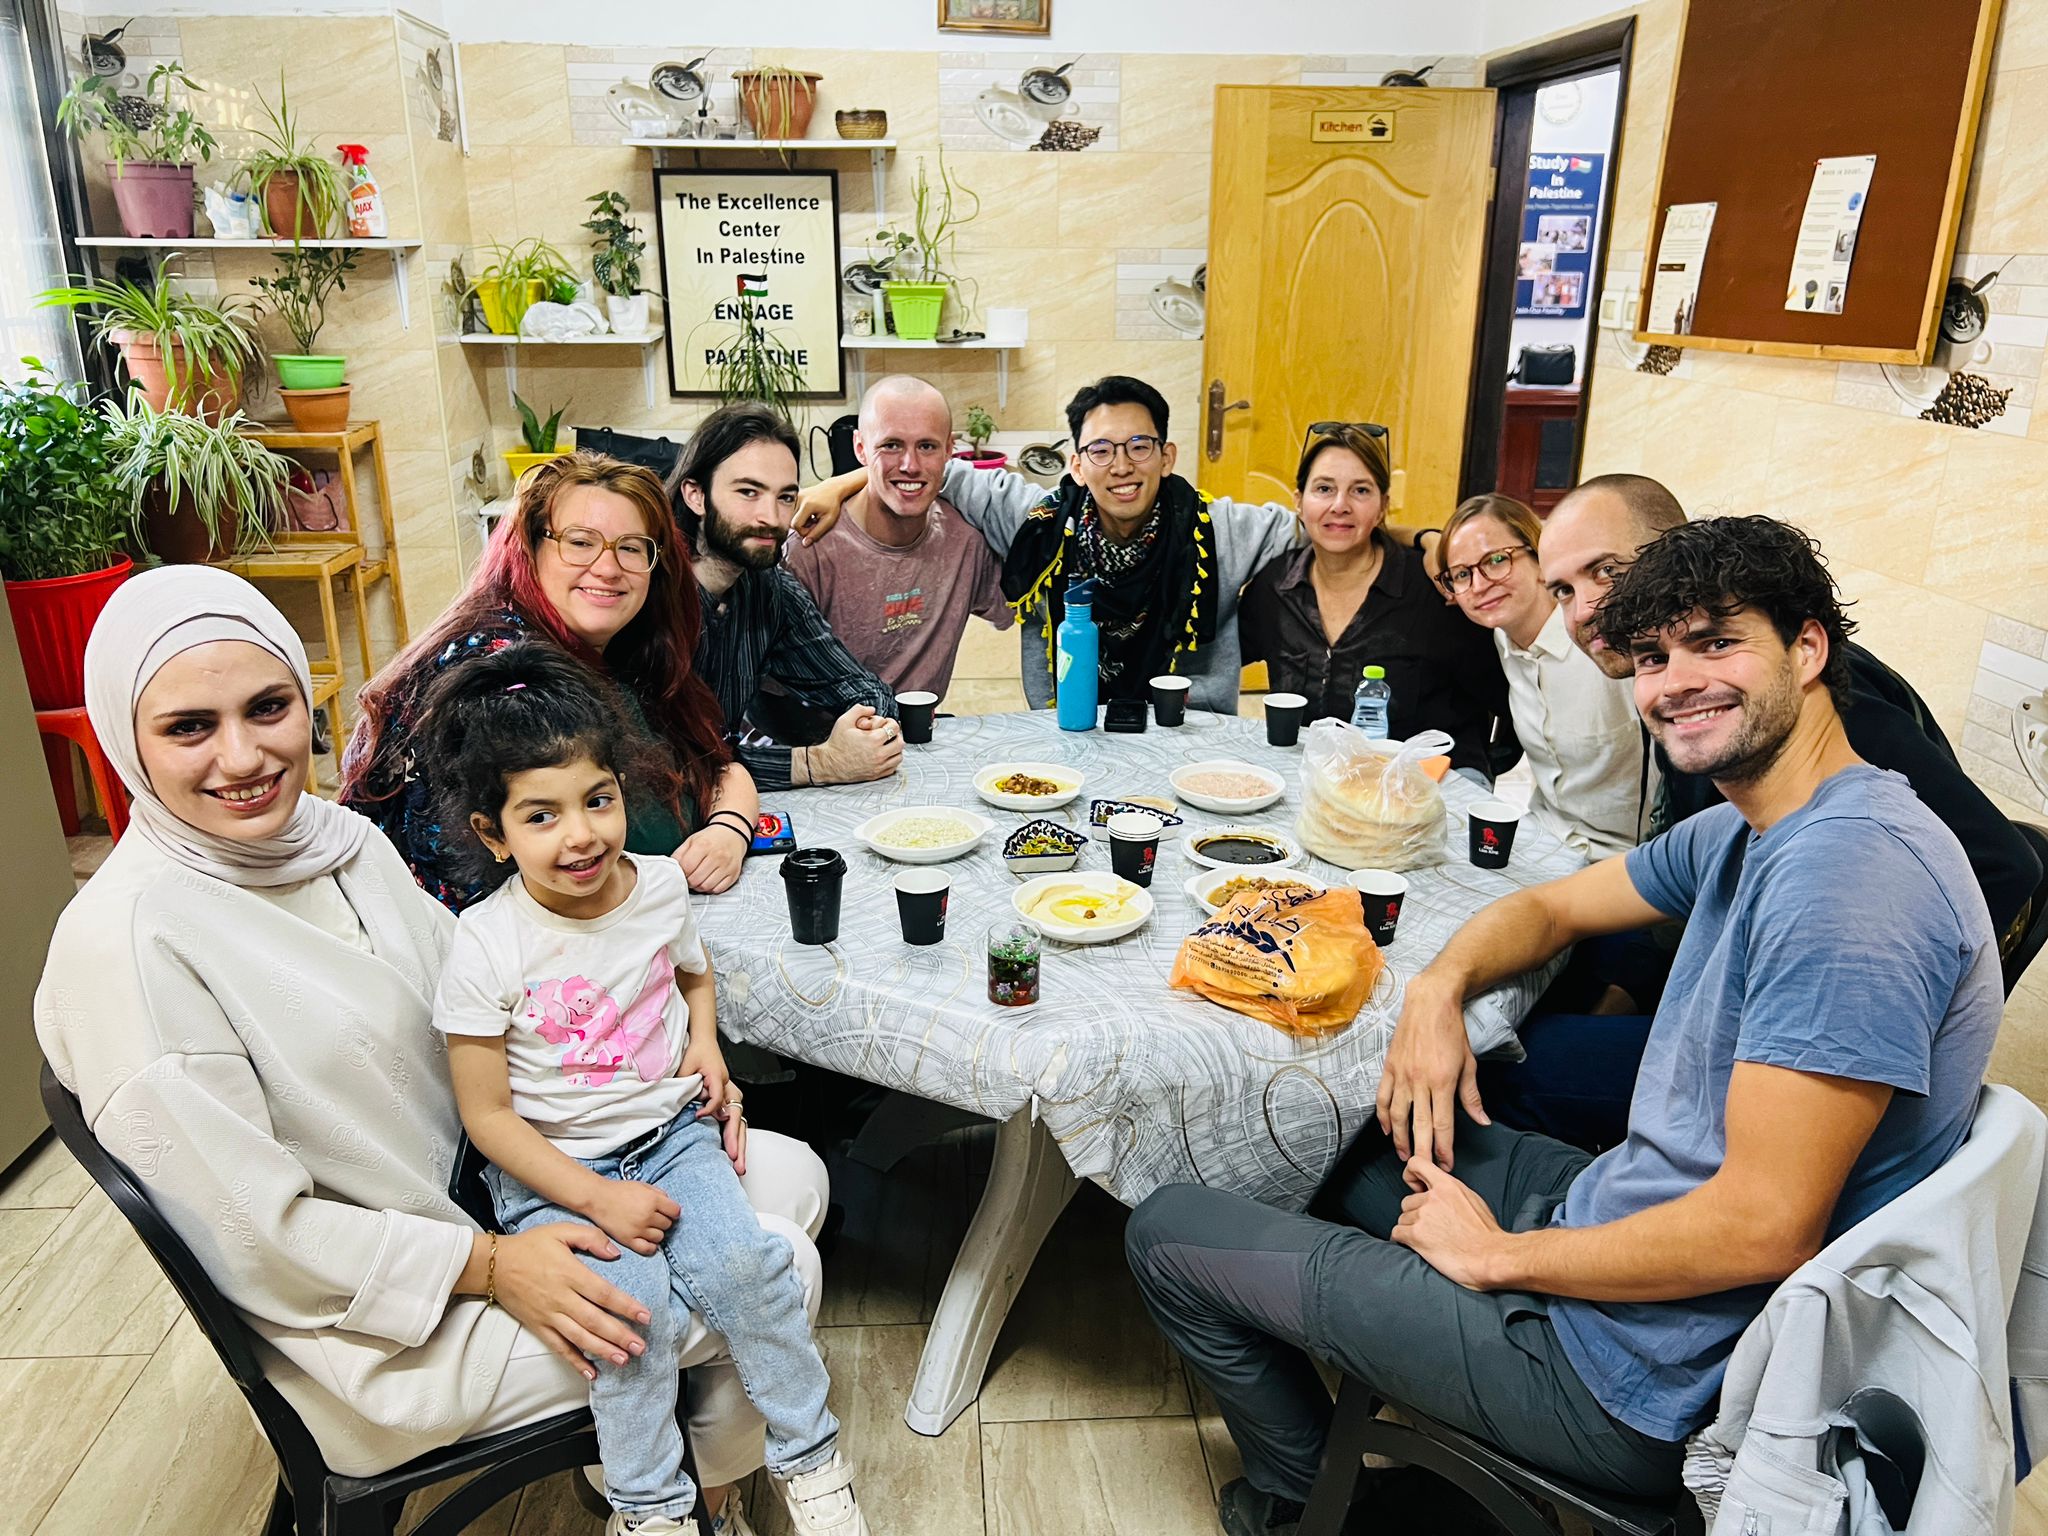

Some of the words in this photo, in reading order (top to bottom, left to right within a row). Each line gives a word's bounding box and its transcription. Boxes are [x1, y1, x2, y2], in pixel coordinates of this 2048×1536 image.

[1320, 121, 1362, 132] Kitchen
[1529, 155, 1569, 173] Study
[1551, 173, 1565, 186] In
[1529, 186, 1583, 199] Palestine
[355, 201, 373, 215] AJAX
[675, 193, 711, 210] The
[718, 193, 820, 210] Excellence
[719, 220, 781, 237] Center
[696, 247, 714, 264] In
[720, 248, 806, 264] Palestine
[705, 349, 808, 365] PALETINE
